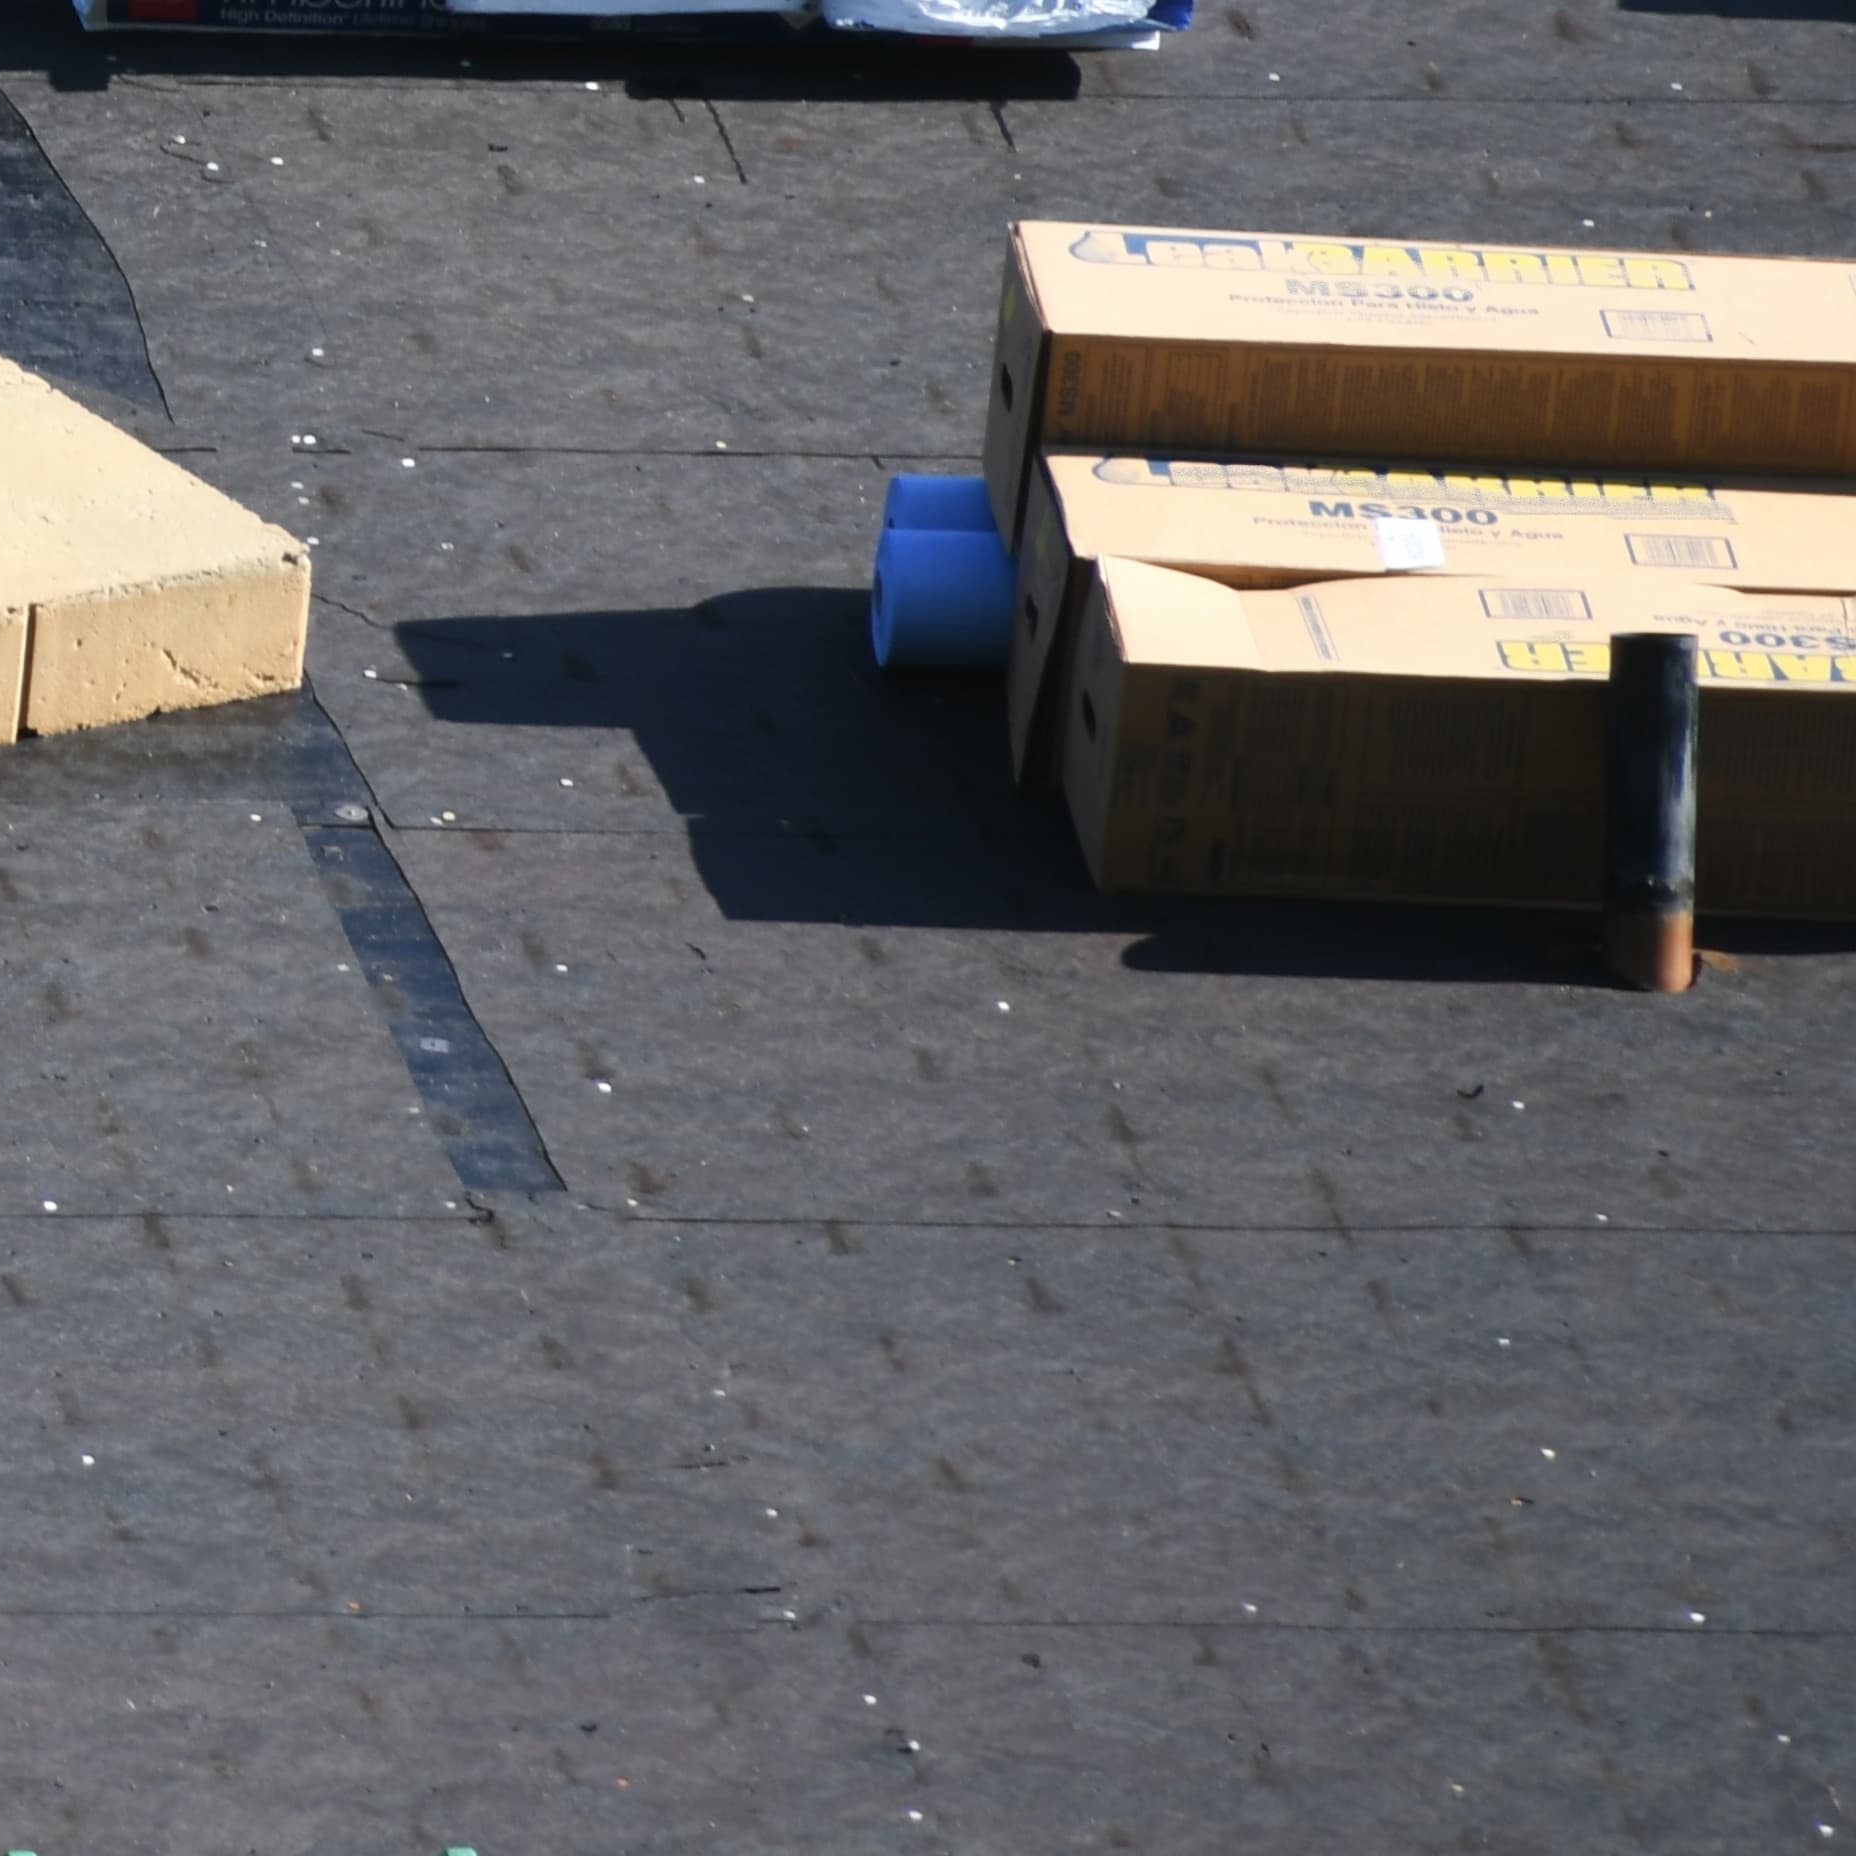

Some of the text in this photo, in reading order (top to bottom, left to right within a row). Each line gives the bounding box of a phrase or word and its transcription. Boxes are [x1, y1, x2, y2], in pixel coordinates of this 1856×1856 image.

[220, 6, 259, 24] High
[1284, 278, 1475, 302] MS300
[1307, 500, 1499, 526] MS300
